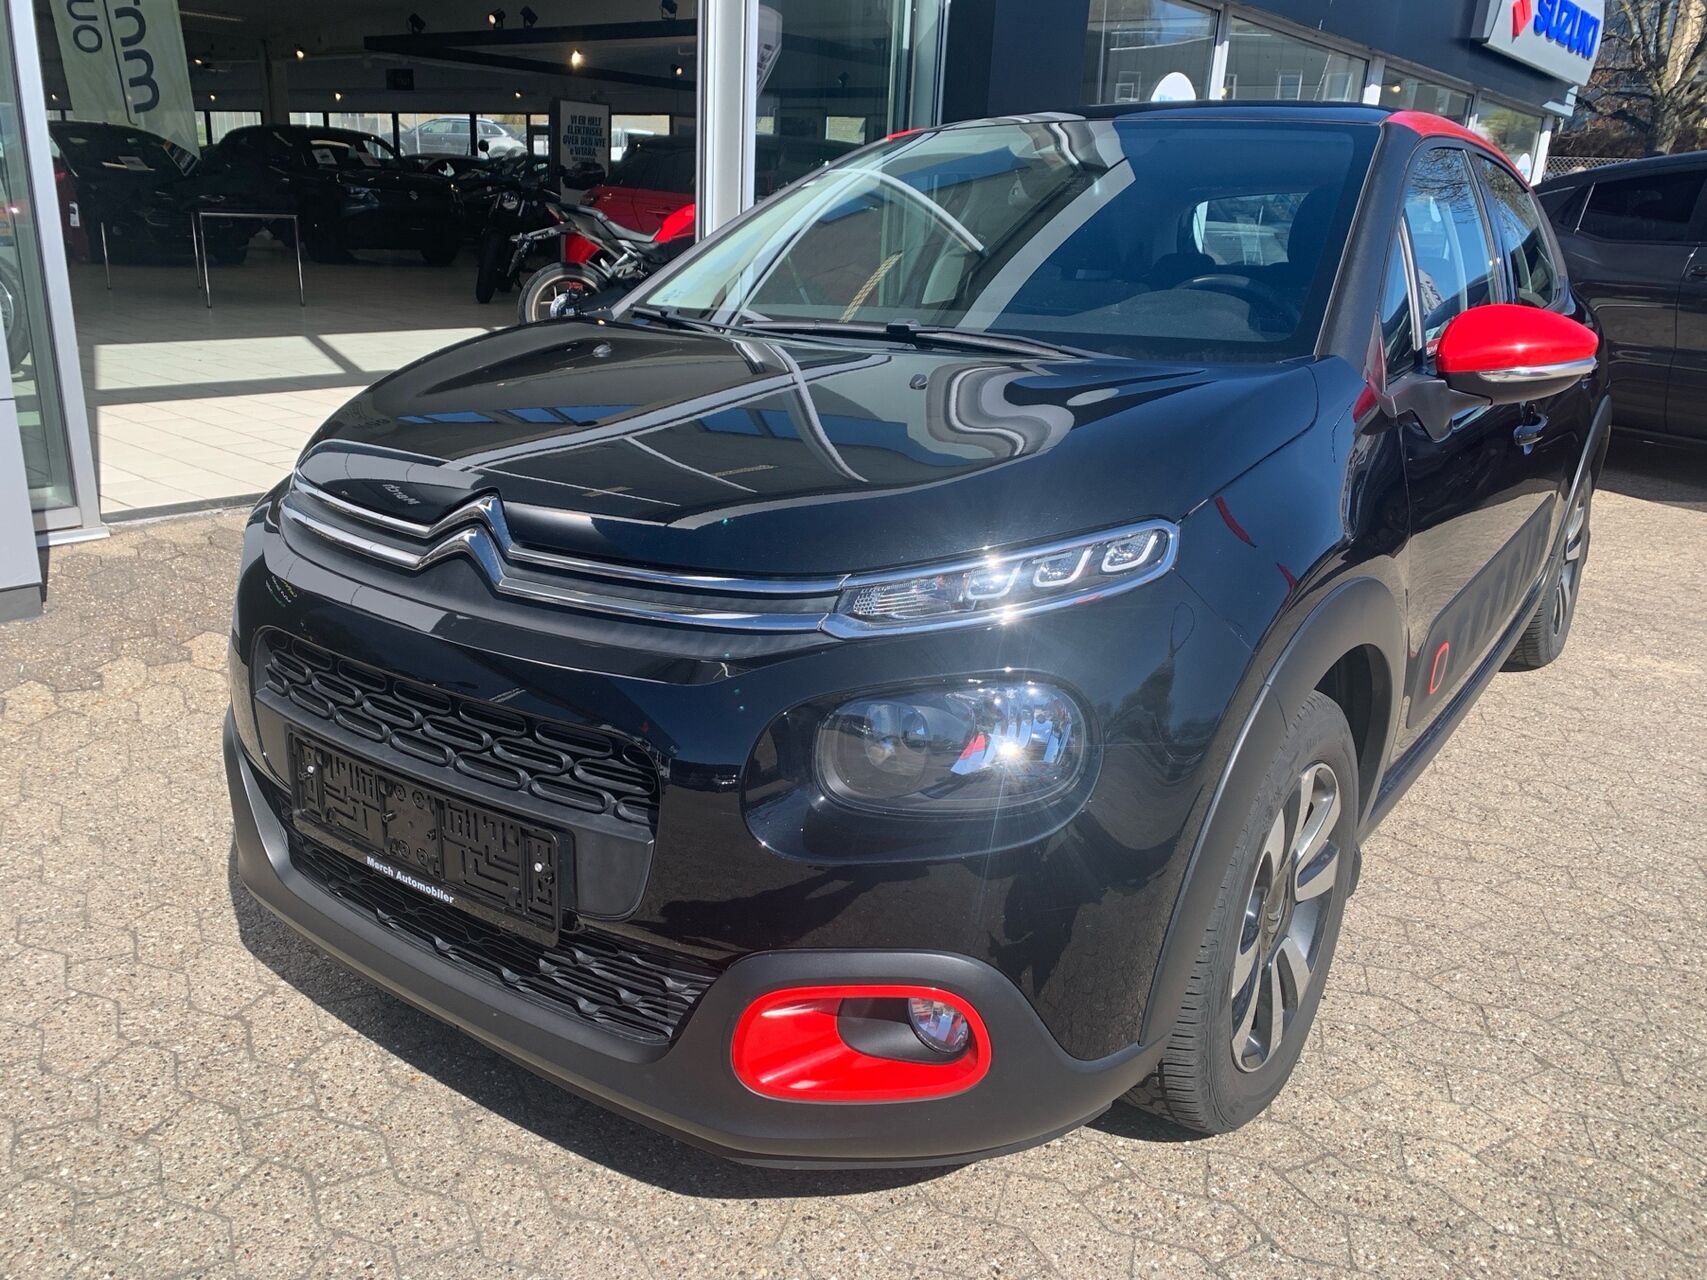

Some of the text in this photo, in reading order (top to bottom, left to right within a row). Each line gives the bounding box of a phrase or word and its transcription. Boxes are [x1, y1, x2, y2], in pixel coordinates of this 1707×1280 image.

[1534, 0, 1600, 60] SUZUKI
[562, 135, 579, 144] OVER
[567, 125, 603, 136] ELEKTRISKE
[366, 855, 455, 904] Mørch Automobiler
